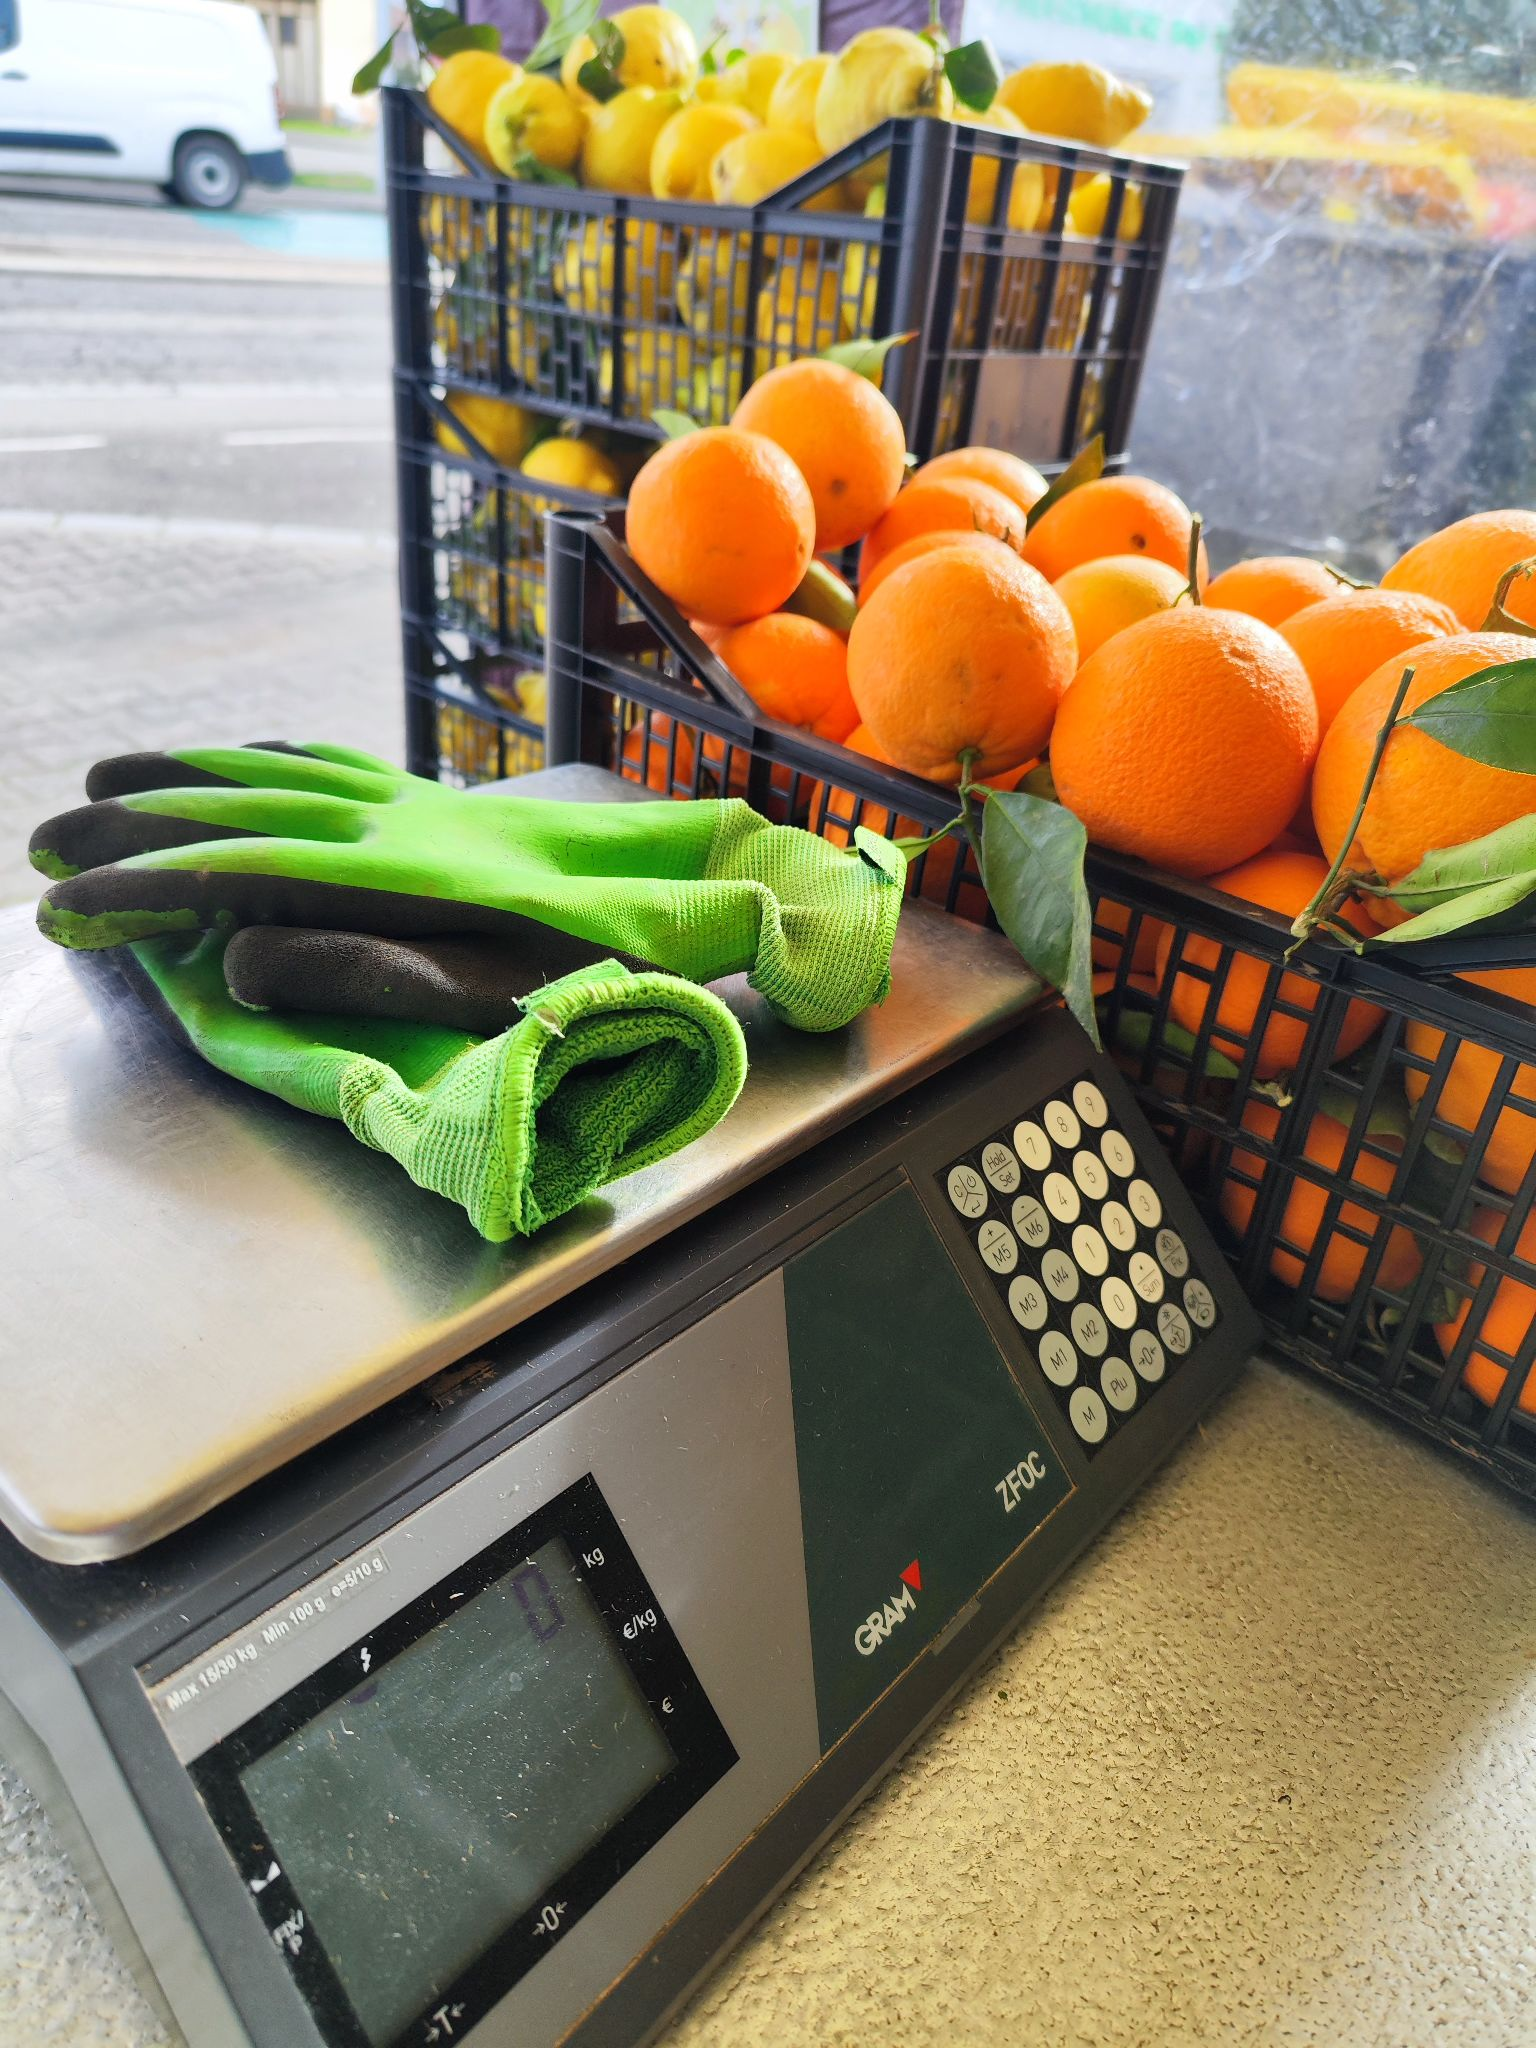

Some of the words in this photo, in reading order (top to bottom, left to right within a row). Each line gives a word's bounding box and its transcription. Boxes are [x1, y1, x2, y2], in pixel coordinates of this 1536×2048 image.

[1084, 1096, 1095, 1113] 9
[1056, 1116, 1068, 1133] 8
[1026, 1136, 1037, 1155] 7
[1114, 1145, 1123, 1162] 6
[985, 1149, 1006, 1170] Hold
[999, 1171, 1015, 1187] Set
[1083, 1165, 1096, 1184] 5
[1057, 1188, 1068, 1206] 4
[1139, 1195, 1151, 1212] 3
[1025, 1218, 1044, 1240] M6
[1112, 1217, 1125, 1236] 2
[992, 1243, 1011, 1266] M5
[1085, 1241, 1096, 1258] 1
[1051, 1265, 1069, 1288] M4
[1019, 1292, 1038, 1316] M3
[1113, 1294, 1125, 1312] 0
[1080, 1319, 1099, 1343] M2
[1050, 1347, 1068, 1371] M1
[1110, 1376, 1128, 1398] Plu
[1082, 1405, 1096, 1426] M
[994, 1449, 1047, 1514] ZFOC
[582, 1546, 606, 1569] kg
[331, 1564, 372, 1598] e=5/10
[371, 1556, 385, 1573] g
[261, 1618, 290, 1645] Min
[289, 1602, 315, 1625] 100
[315, 1595, 327, 1613] g
[622, 1607, 658, 1640] €/kg
[854, 1583, 918, 1656] GRAM
[165, 1680, 199, 1712] Max
[199, 1655, 237, 1689] 15/30
[239, 1641, 258, 1663] kg
[662, 1696, 675, 1714] €
